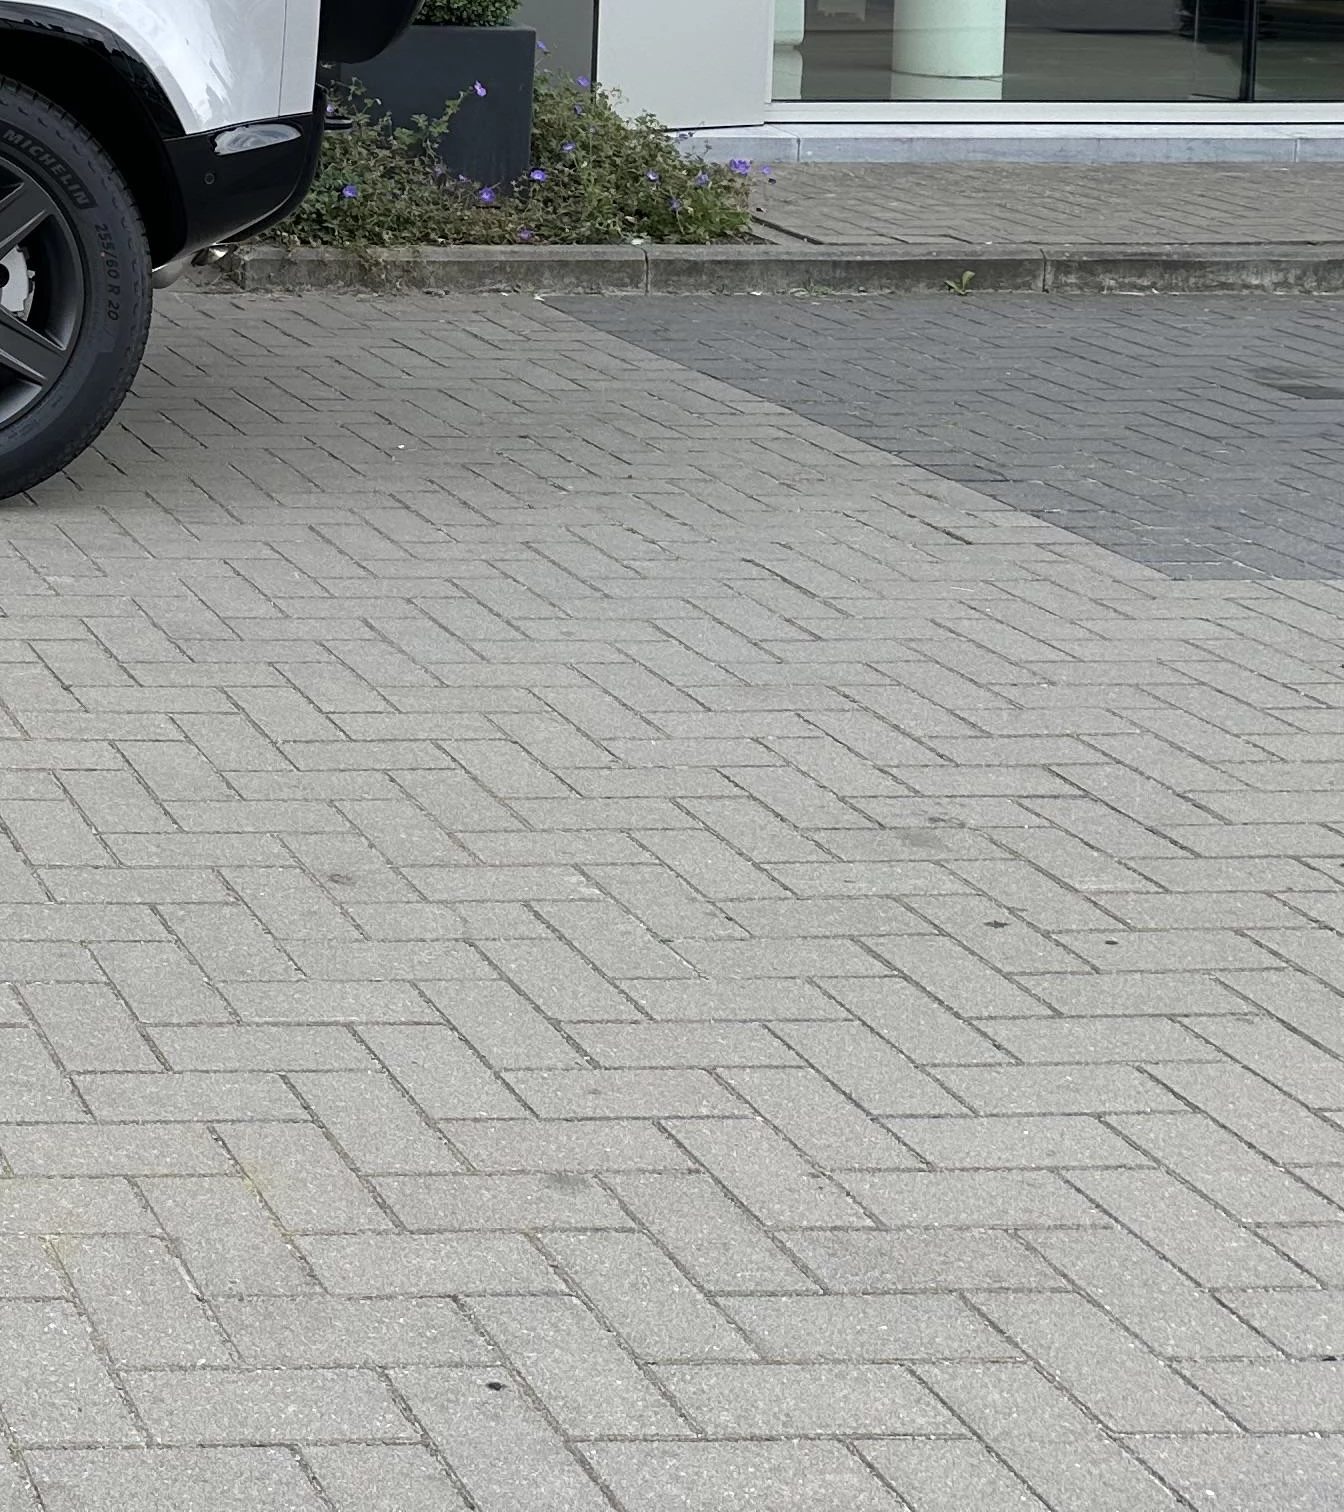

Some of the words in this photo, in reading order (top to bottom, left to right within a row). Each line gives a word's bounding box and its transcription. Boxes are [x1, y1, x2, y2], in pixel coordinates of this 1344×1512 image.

[2, 129, 90, 210] MICHELIN
[95, 223, 121, 279] 255/60
[108, 284, 121, 296] R
[107, 299, 121, 321] 20
